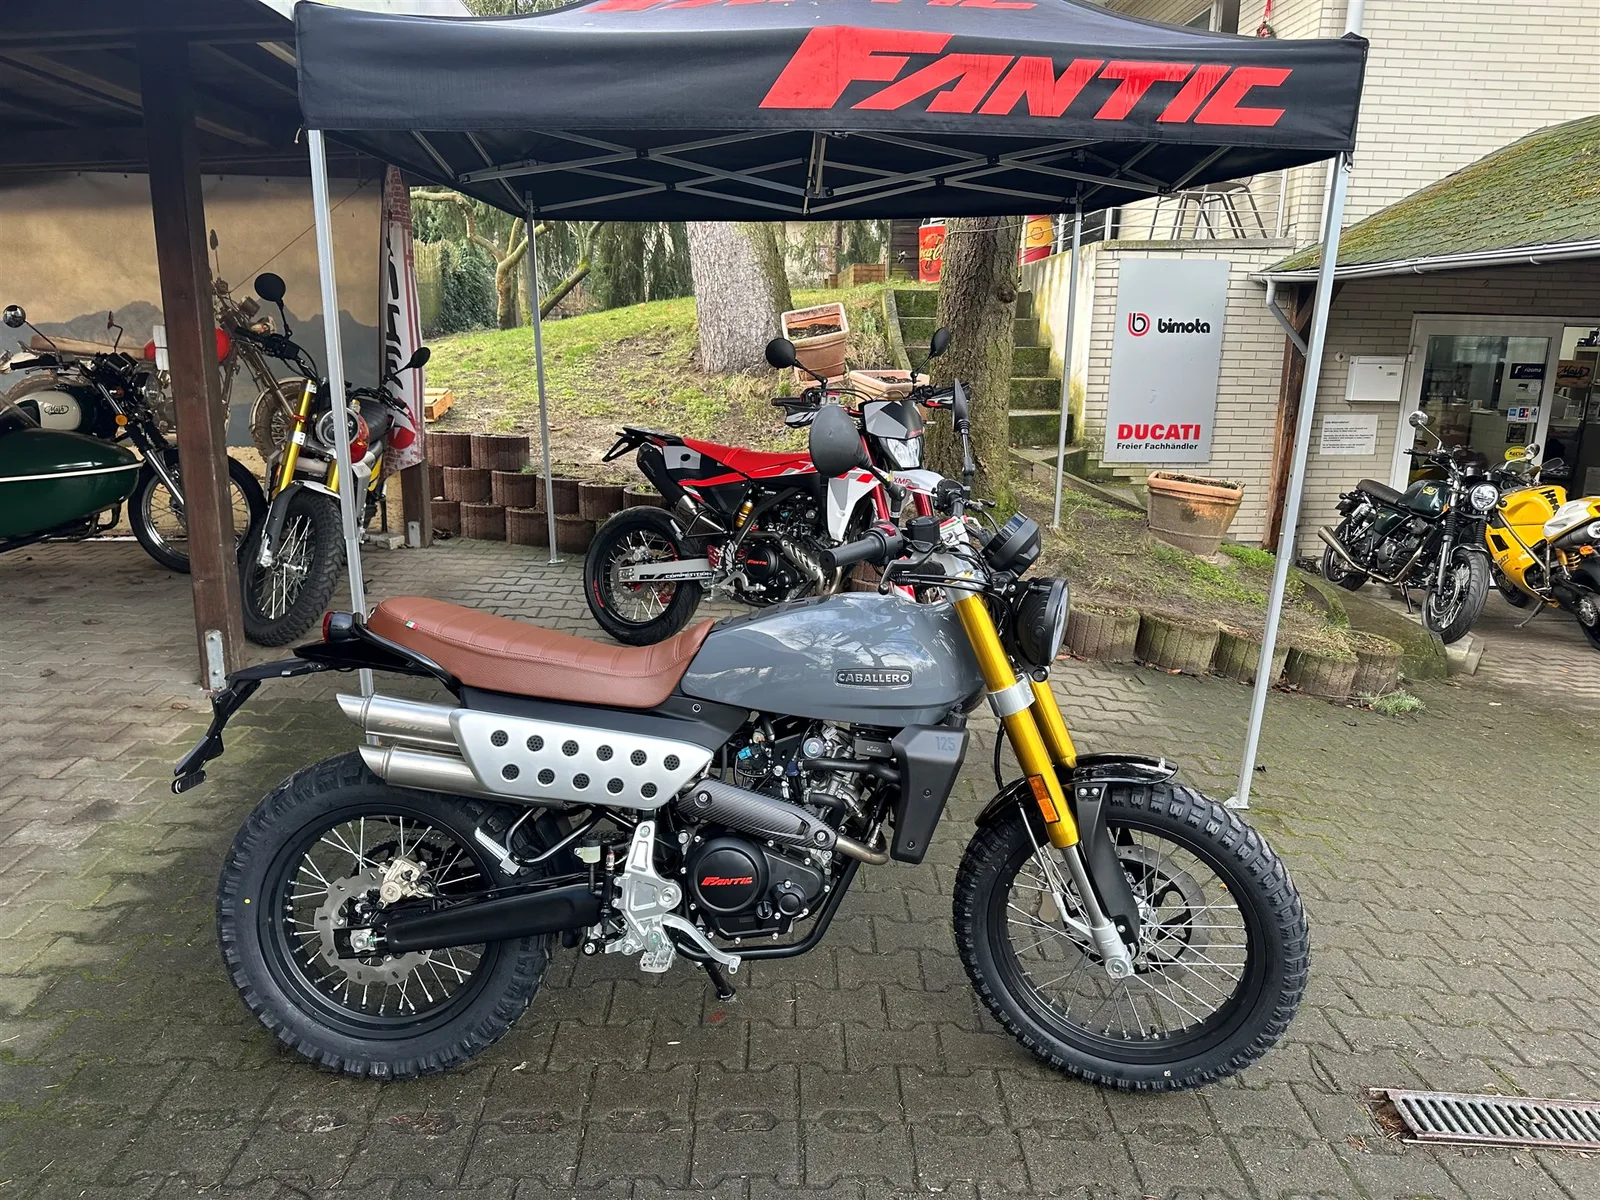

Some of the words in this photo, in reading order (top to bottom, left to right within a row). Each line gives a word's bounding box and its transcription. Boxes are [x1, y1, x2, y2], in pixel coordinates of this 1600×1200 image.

[758, 25, 1293, 126] FANTIC
[1157, 318, 1211, 334] bimota
[1117, 424, 1201, 440] DUCATI
[1116, 442, 1142, 450] Freier
[1144, 442, 1199, 450] Fachhändler
[664, 571, 713, 579] COMPETITION
[837, 673, 910, 683] CABALLERO
[934, 735, 956, 752] 125
[701, 876, 753, 886] FANTIC
